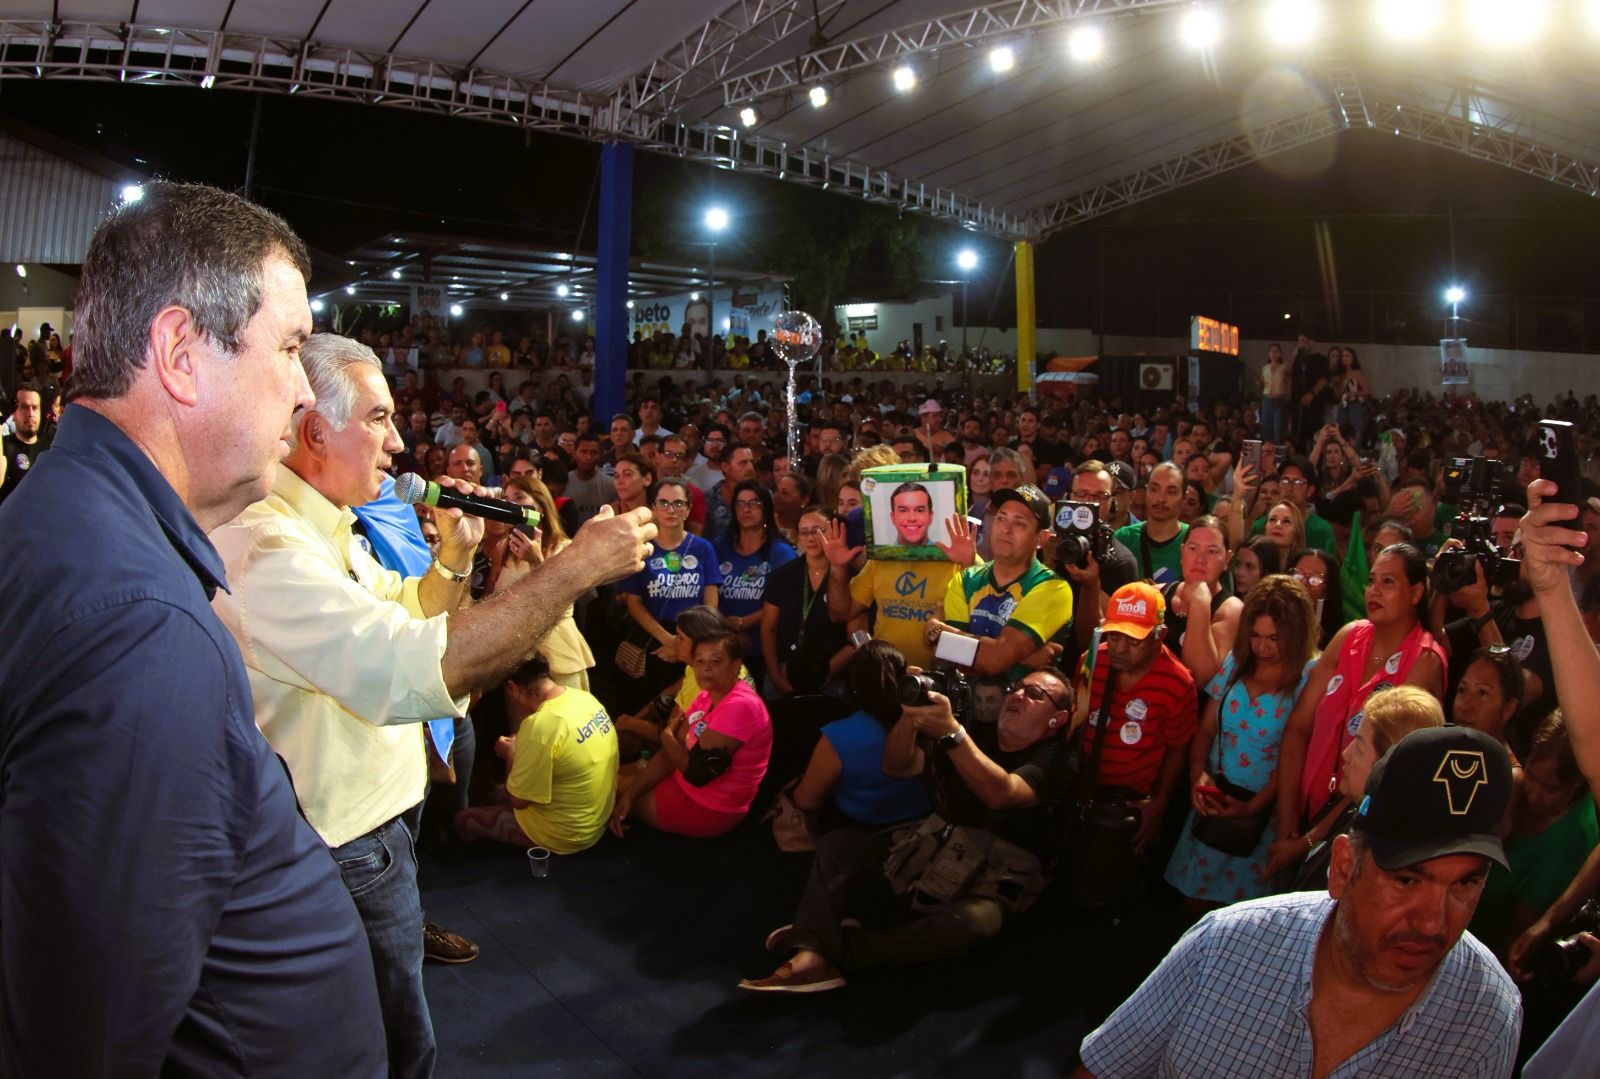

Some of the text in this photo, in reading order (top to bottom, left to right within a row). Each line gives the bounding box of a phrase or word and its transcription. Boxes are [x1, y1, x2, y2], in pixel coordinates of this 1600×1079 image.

[635, 303, 671, 323] beto
[657, 572, 700, 587] O LEGADO
[723, 574, 733, 586] O
[1116, 595, 1147, 616] Tenda
